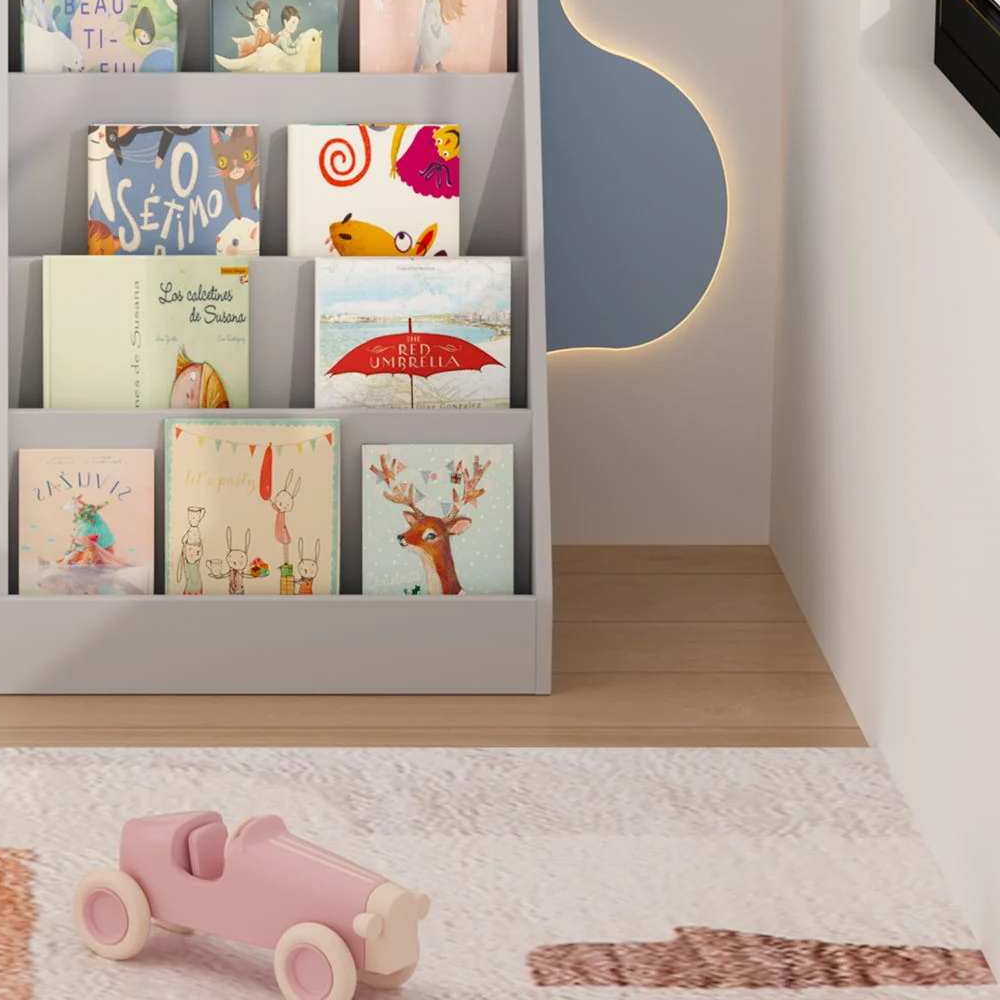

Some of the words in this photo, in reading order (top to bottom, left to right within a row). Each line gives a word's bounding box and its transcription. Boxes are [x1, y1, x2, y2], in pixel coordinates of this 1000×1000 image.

[83, 28, 118, 49] TI-
[170, 141, 199, 198] O
[158, 281, 184, 305] Los
[186, 284, 234, 302] calcetines
[130, 280, 142, 349] Susana
[189, 306, 202, 324] de
[203, 304, 247, 324] Susana
[397, 343, 432, 356] RED
[406, 335, 422, 343] THE
[130, 354, 141, 375] de
[369, 355, 461, 371] UMBRELLA
